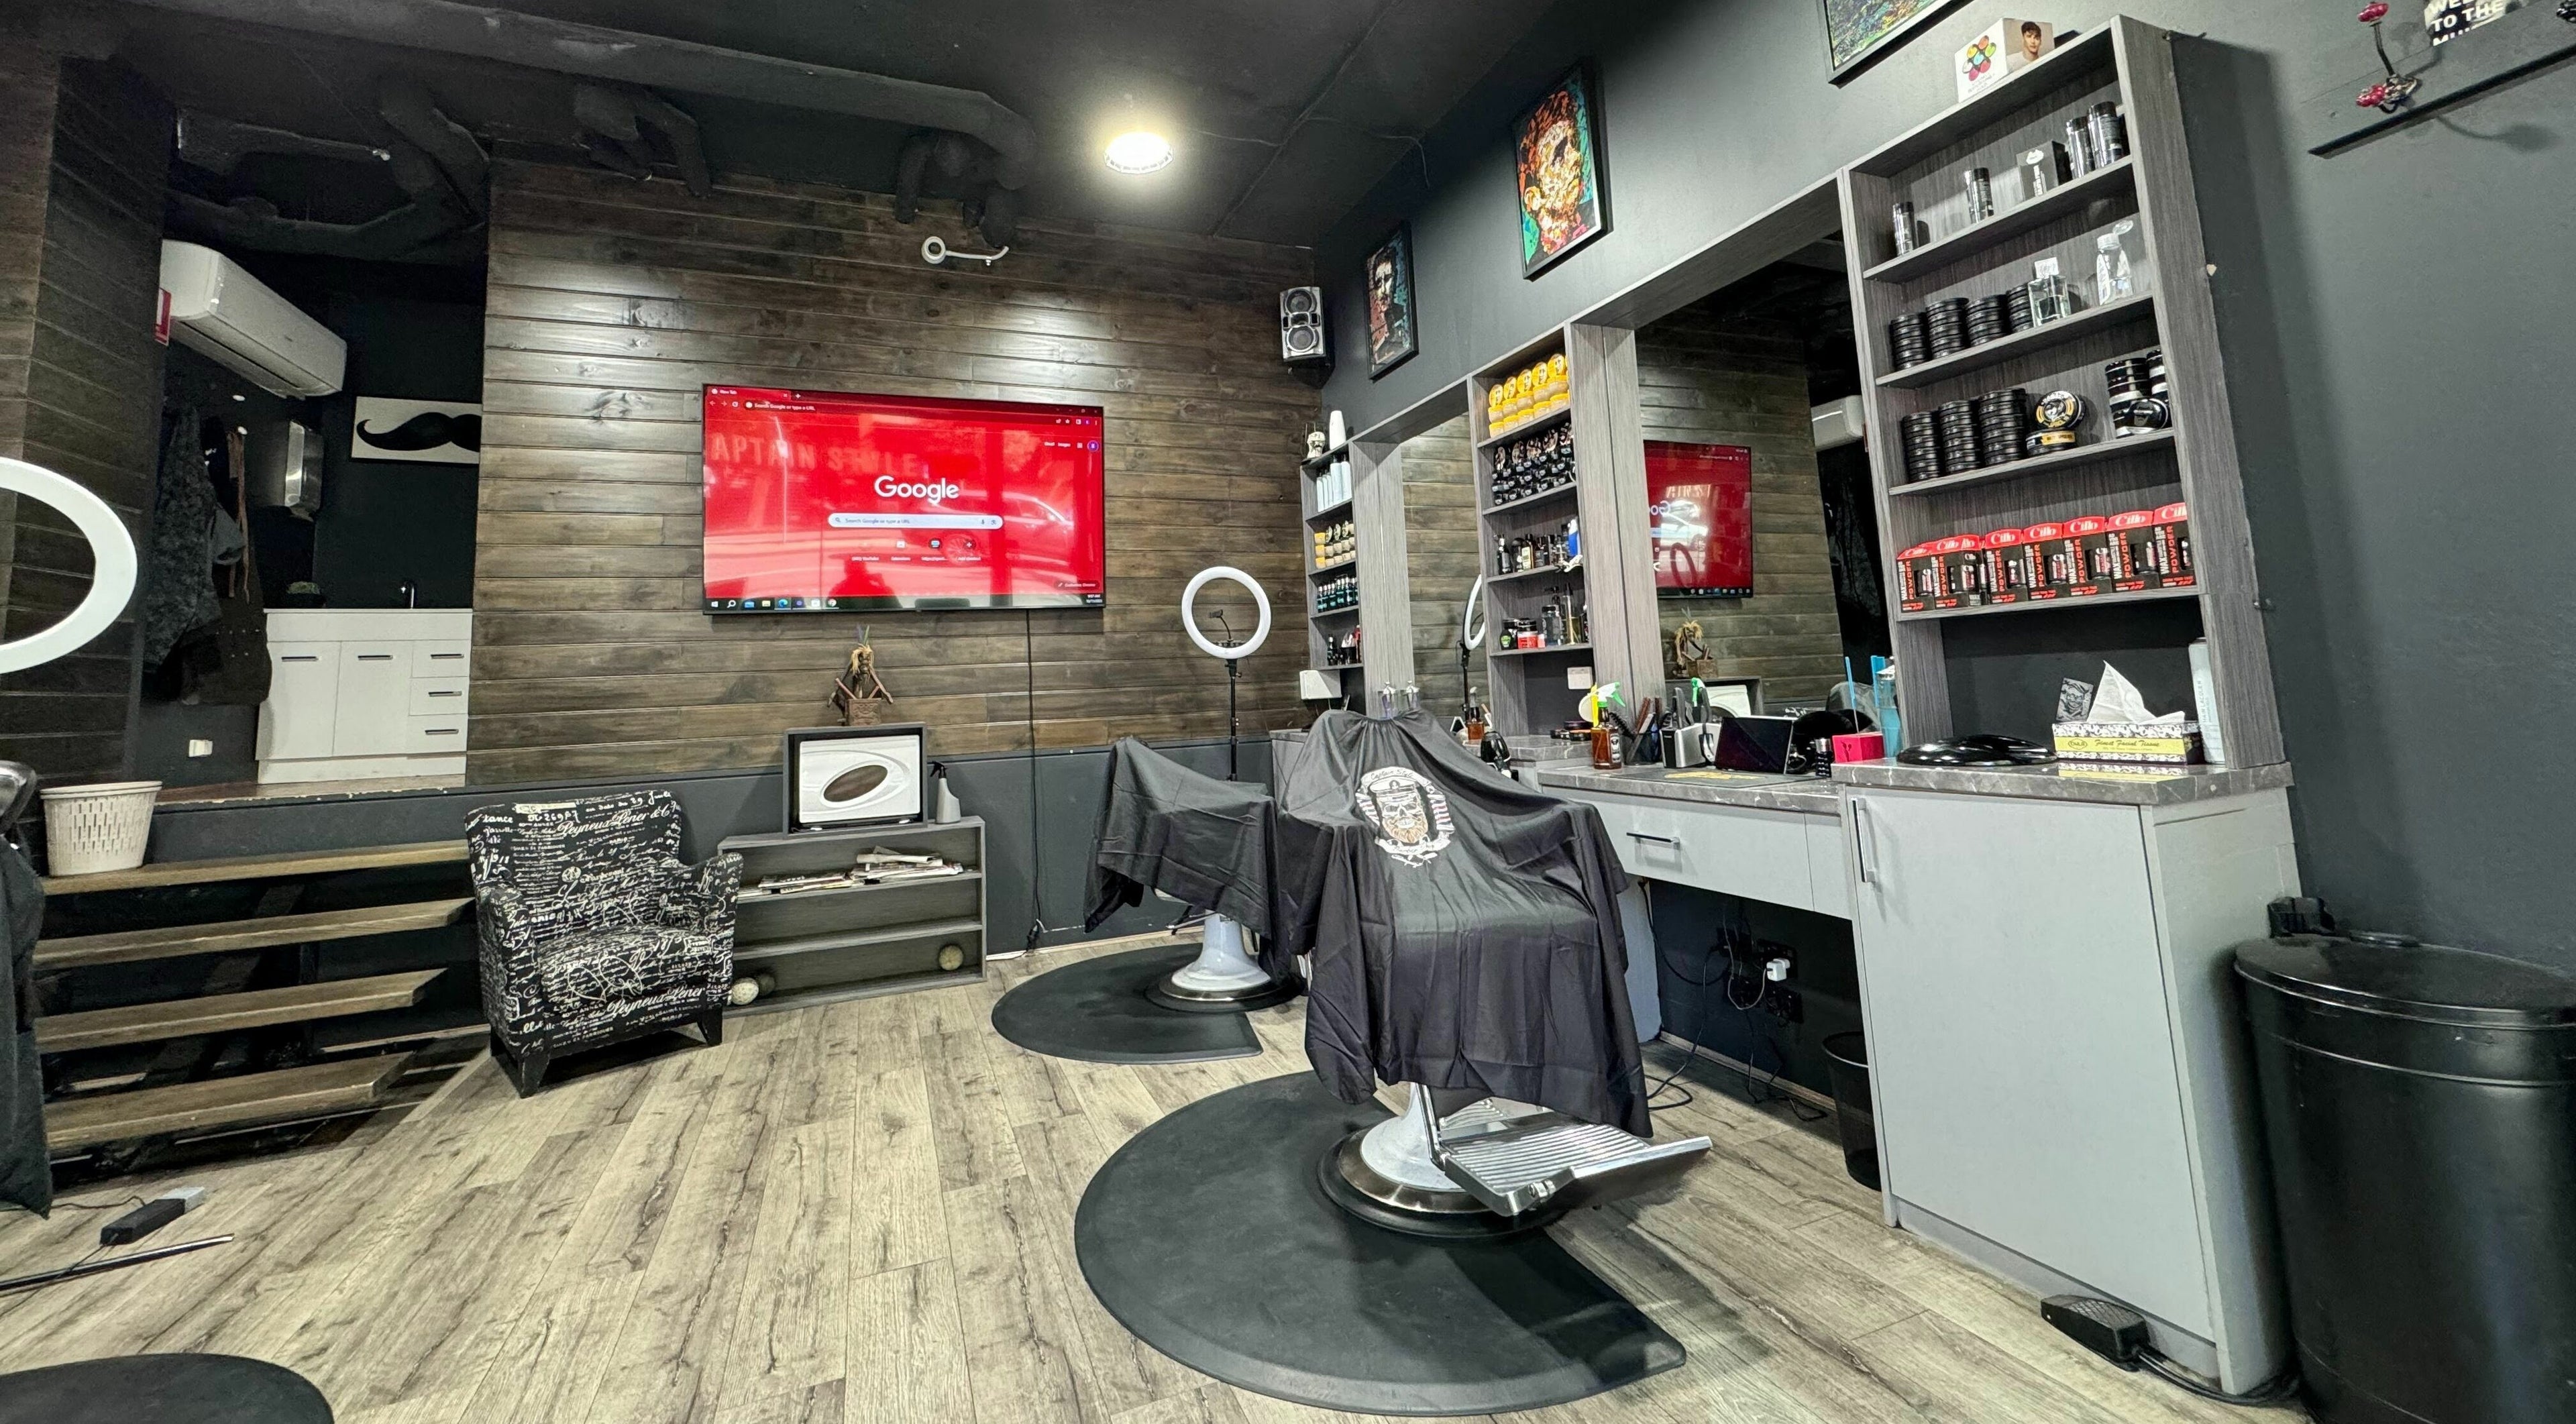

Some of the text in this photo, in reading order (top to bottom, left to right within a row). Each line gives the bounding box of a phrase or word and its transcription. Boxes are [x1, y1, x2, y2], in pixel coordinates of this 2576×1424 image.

[2431, 1, 2505, 32] TO THE
[874, 475, 959, 505] Google
[2115, 513, 2147, 527] Cillo
[2161, 505, 2187, 519] Cill
[2029, 526, 2057, 539] Cillo
[2070, 520, 2099, 533] Cillo
[1990, 532, 2016, 545] Cillo
[2120, 532, 2132, 578] POWDER
[2166, 525, 2180, 573] POWDER
[2034, 544, 2045, 588] POWDER
[2074, 539, 2086, 584] POWDER
[2159, 557, 2169, 575] WAX
[1939, 556, 1947, 596] POWDER
[1995, 550, 2005, 592] POWDER
[2068, 568, 2078, 584] WAX
[2112, 563, 2123, 580] WAX
[2028, 572, 2037, 588] WAX
[2139, 739, 2159, 747] Tissue
